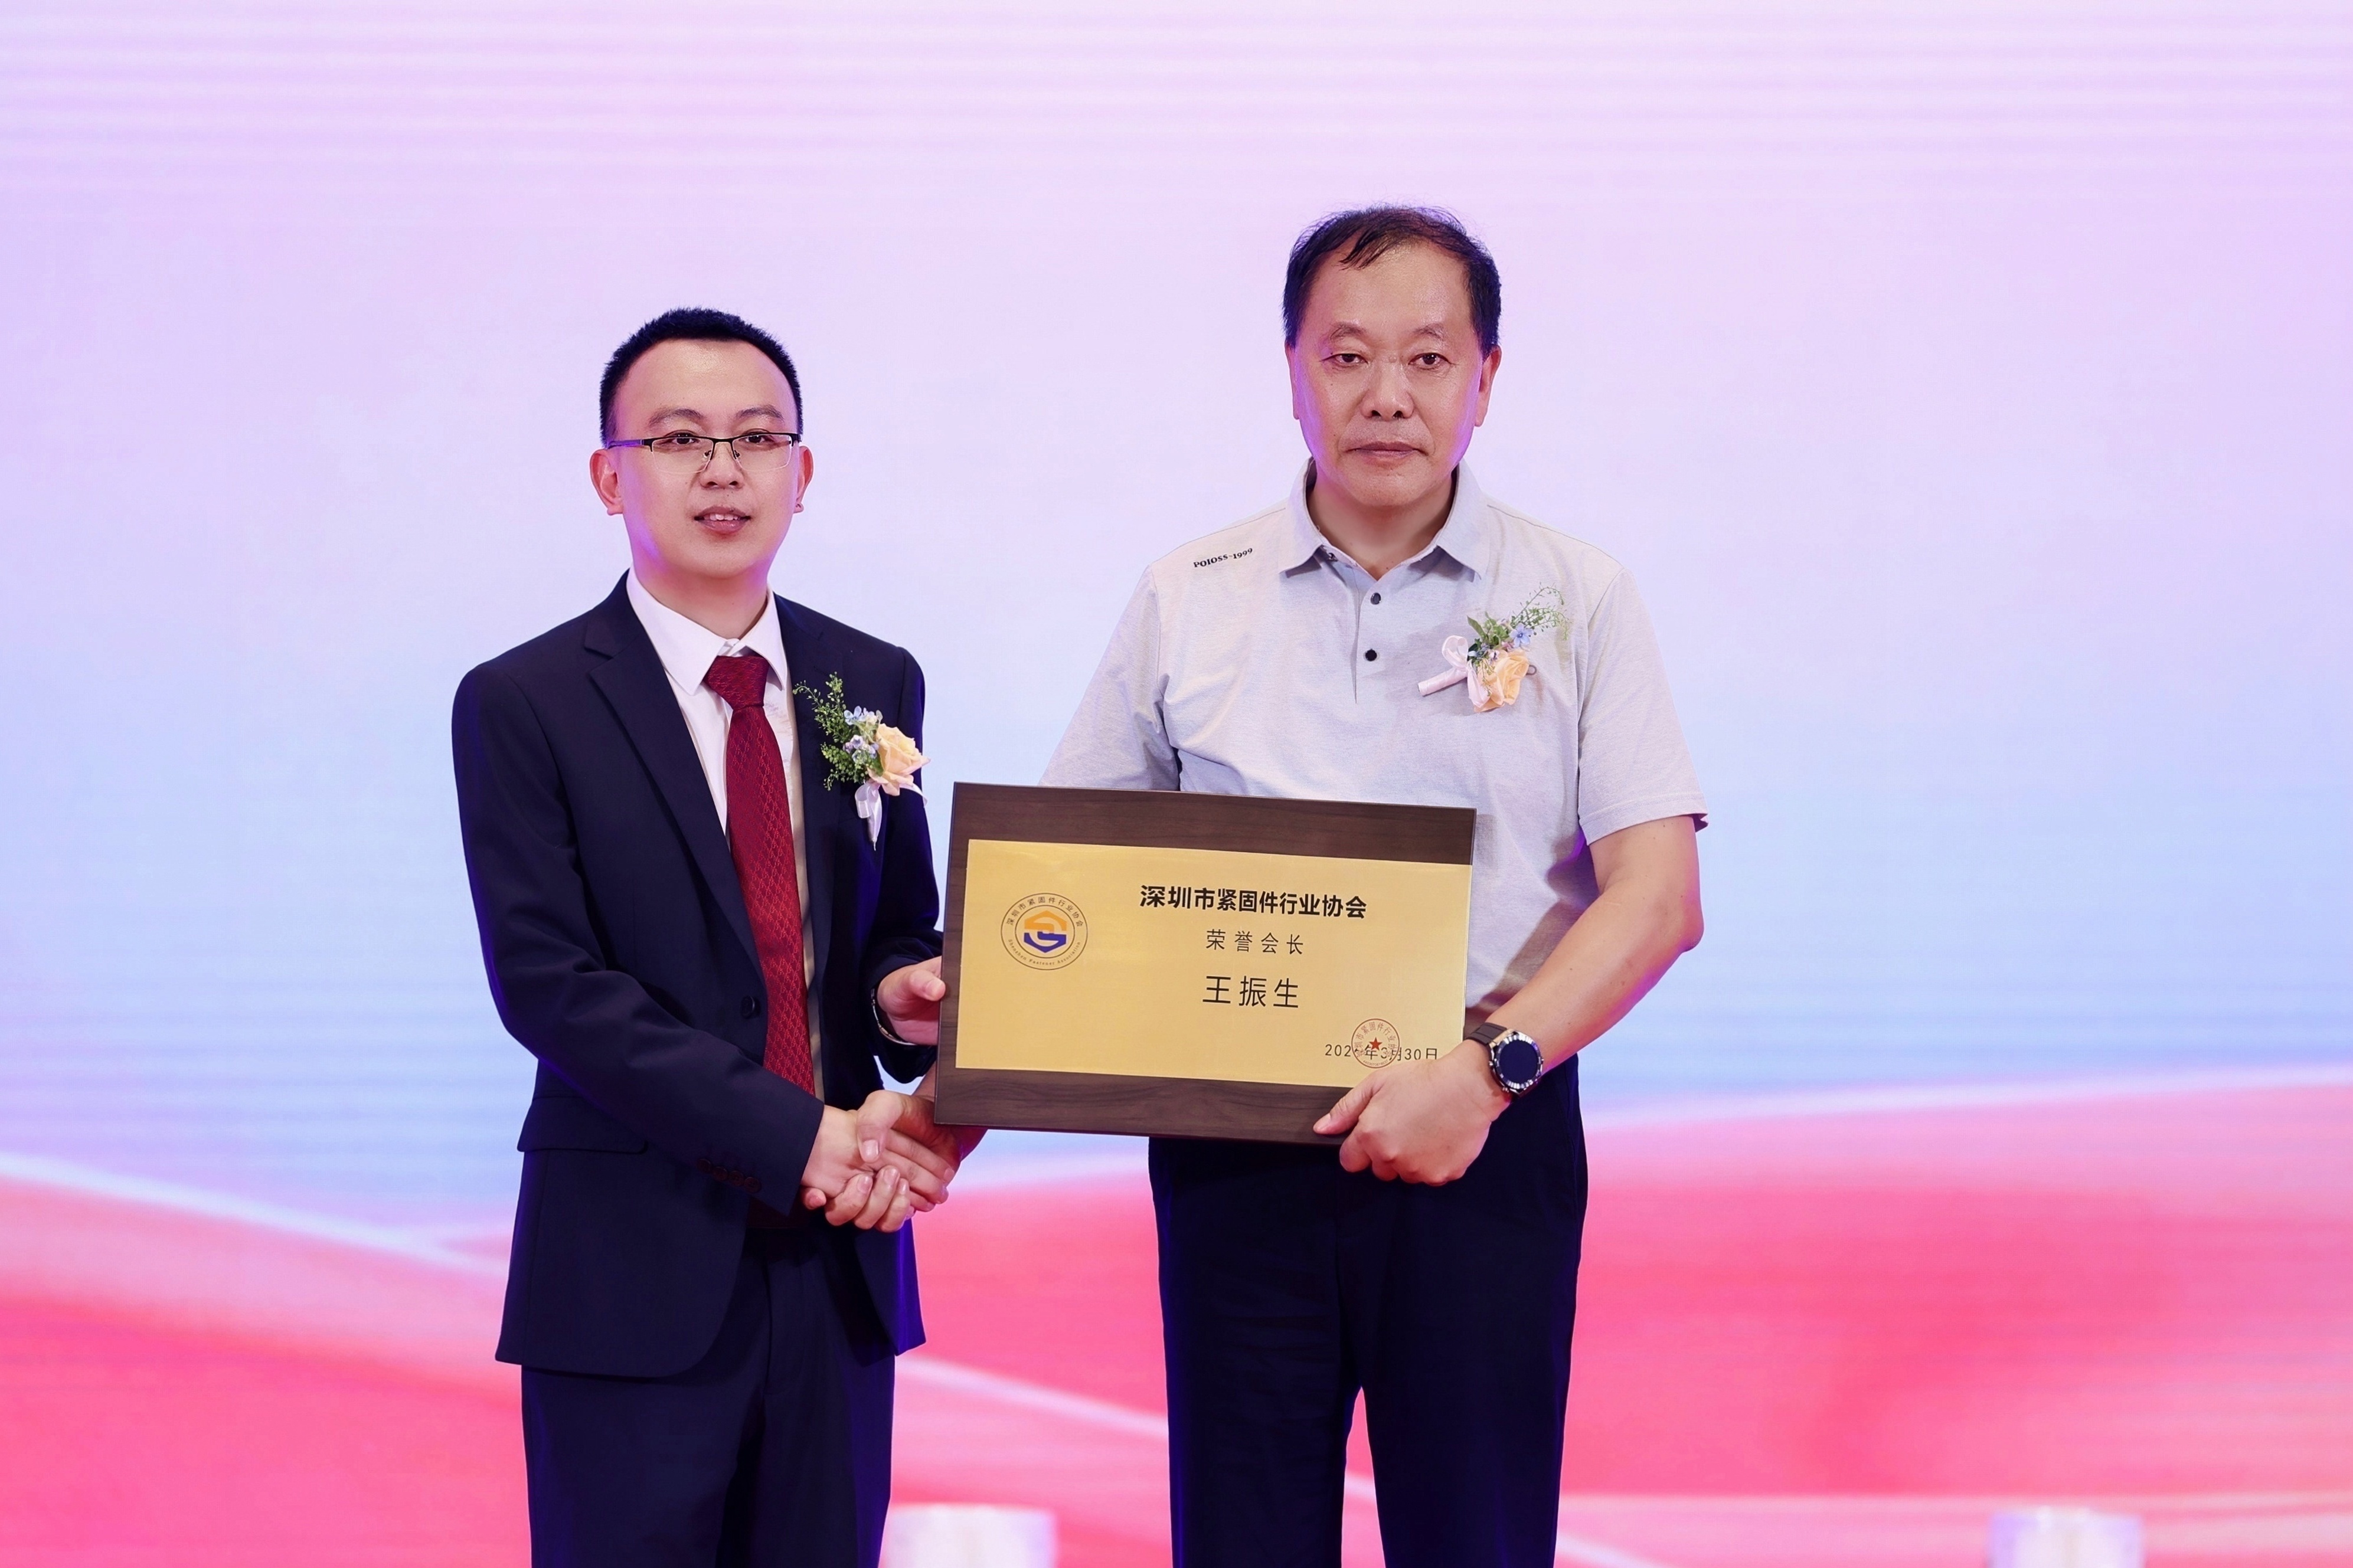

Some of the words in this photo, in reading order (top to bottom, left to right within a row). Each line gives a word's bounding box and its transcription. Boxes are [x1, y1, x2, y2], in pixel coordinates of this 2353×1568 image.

[1006, 896, 1084, 927] 深圳市紧固件行业协会
[1140, 885, 1367, 919] 深圳市紧固件行业协会
[1057, 942, 1081, 963] Association
[1206, 928, 1303, 955] 荣誉会长
[1202, 975, 1299, 1009] 王振生
[1325, 1043, 1437, 1061] 202年3月30日
